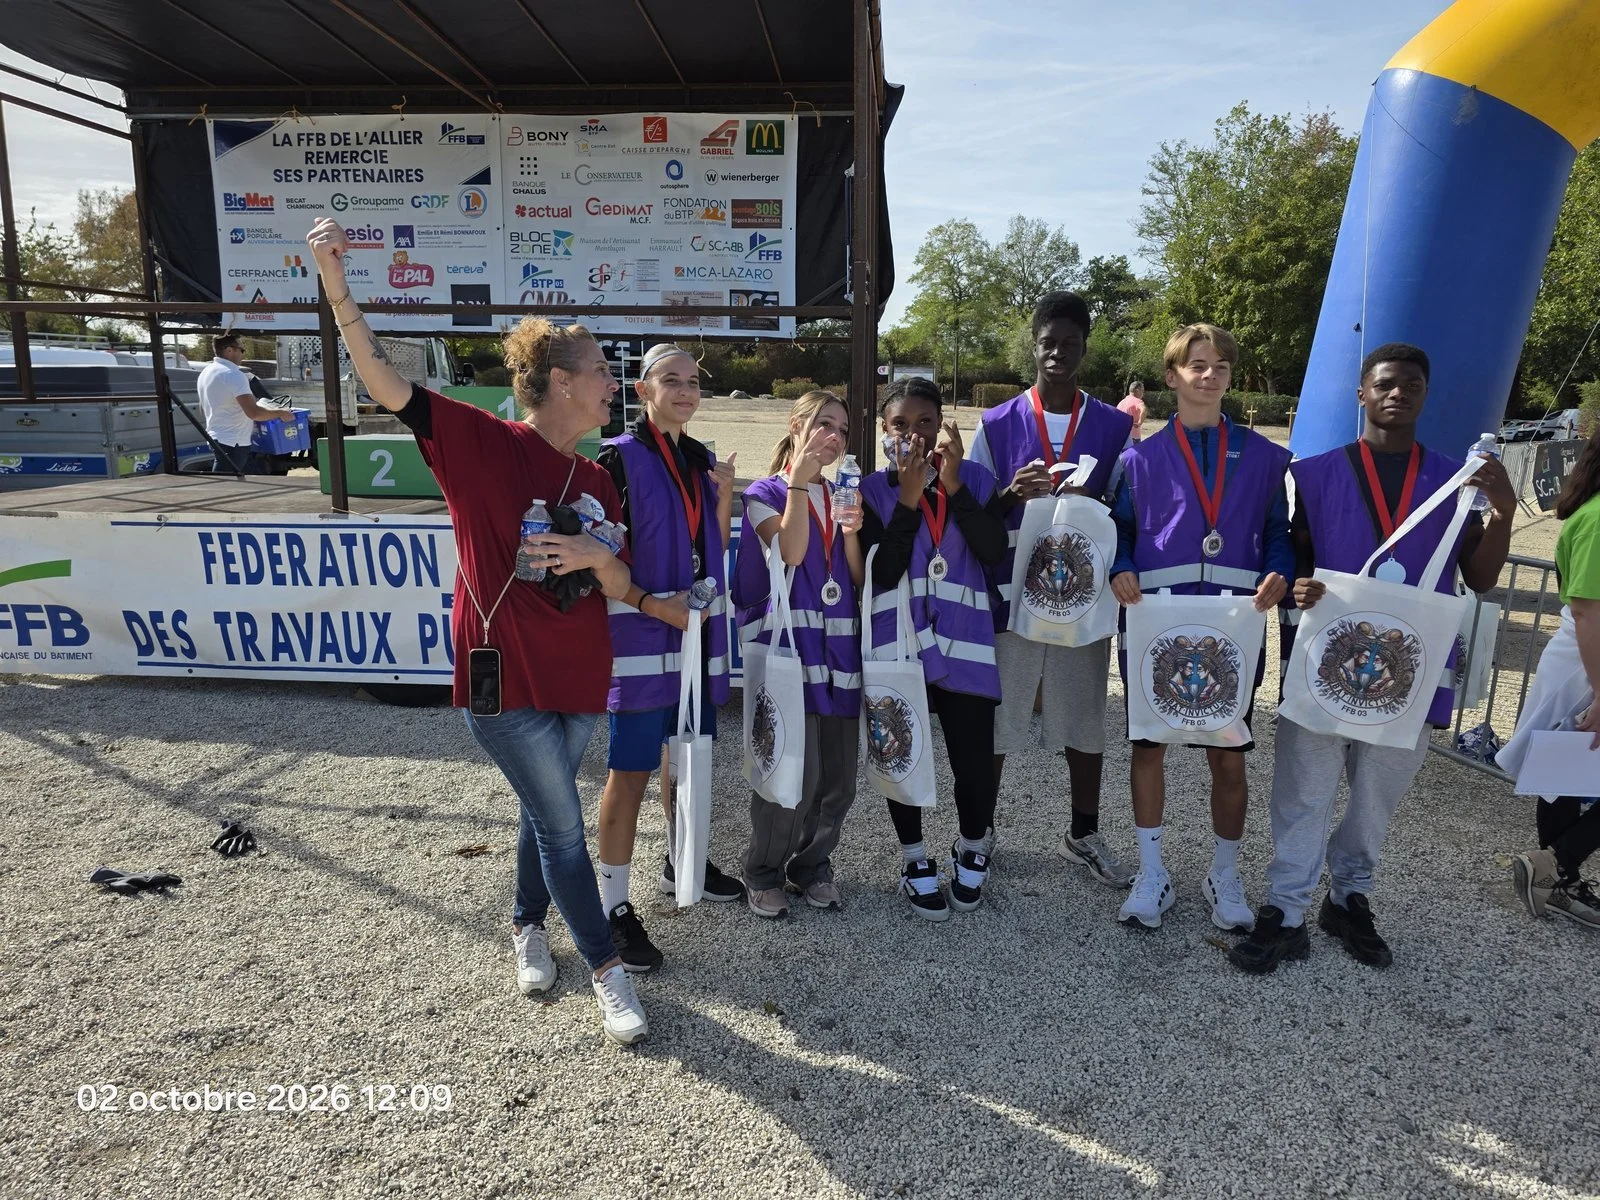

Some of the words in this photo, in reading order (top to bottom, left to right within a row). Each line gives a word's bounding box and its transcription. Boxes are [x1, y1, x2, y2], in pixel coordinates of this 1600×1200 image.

[273, 133, 293, 147] LA
[297, 132, 327, 147] FFB
[331, 132, 351, 146] DE
[355, 130, 423, 146] L'ALLIER
[448, 134, 466, 143] FFB
[527, 132, 569, 141] BONY
[305, 150, 389, 165] REMERCIE
[273, 168, 303, 183] SES
[308, 168, 424, 183] PARTENAIRES
[721, 173, 779, 184] wienerberger
[223, 192, 275, 211] BigMat
[351, 196, 404, 209] Groupama
[411, 195, 450, 208] GRDF
[664, 198, 727, 209] FONDATION
[528, 205, 572, 218] actual
[345, 224, 384, 241] esio
[510, 231, 551, 243] BLOC
[394, 237, 411, 246] AXA
[510, 243, 551, 254] ZONE
[759, 250, 782, 261] FFB
[228, 269, 288, 277] CERFRANCE
[393, 273, 403, 283] Le
[403, 269, 430, 283] PAL
[532, 279, 553, 288] BTP
[498, 396, 515, 421] 1
[369, 449, 396, 487] 2
[198, 531, 440, 588] FEDERATION
[1048, 609, 1061, 617] FFB
[1062, 609, 1071, 617] 03
[122, 609, 197, 660] DES
[214, 611, 397, 665] TRAVAUX
[34, 652, 46, 660] DU
[51, 652, 93, 660] BATIMENT
[1341, 704, 1356, 716] FFB
[1357, 709, 1367, 717] 03
[1181, 717, 1196, 726] FFB
[1197, 718, 1207, 726] 03
